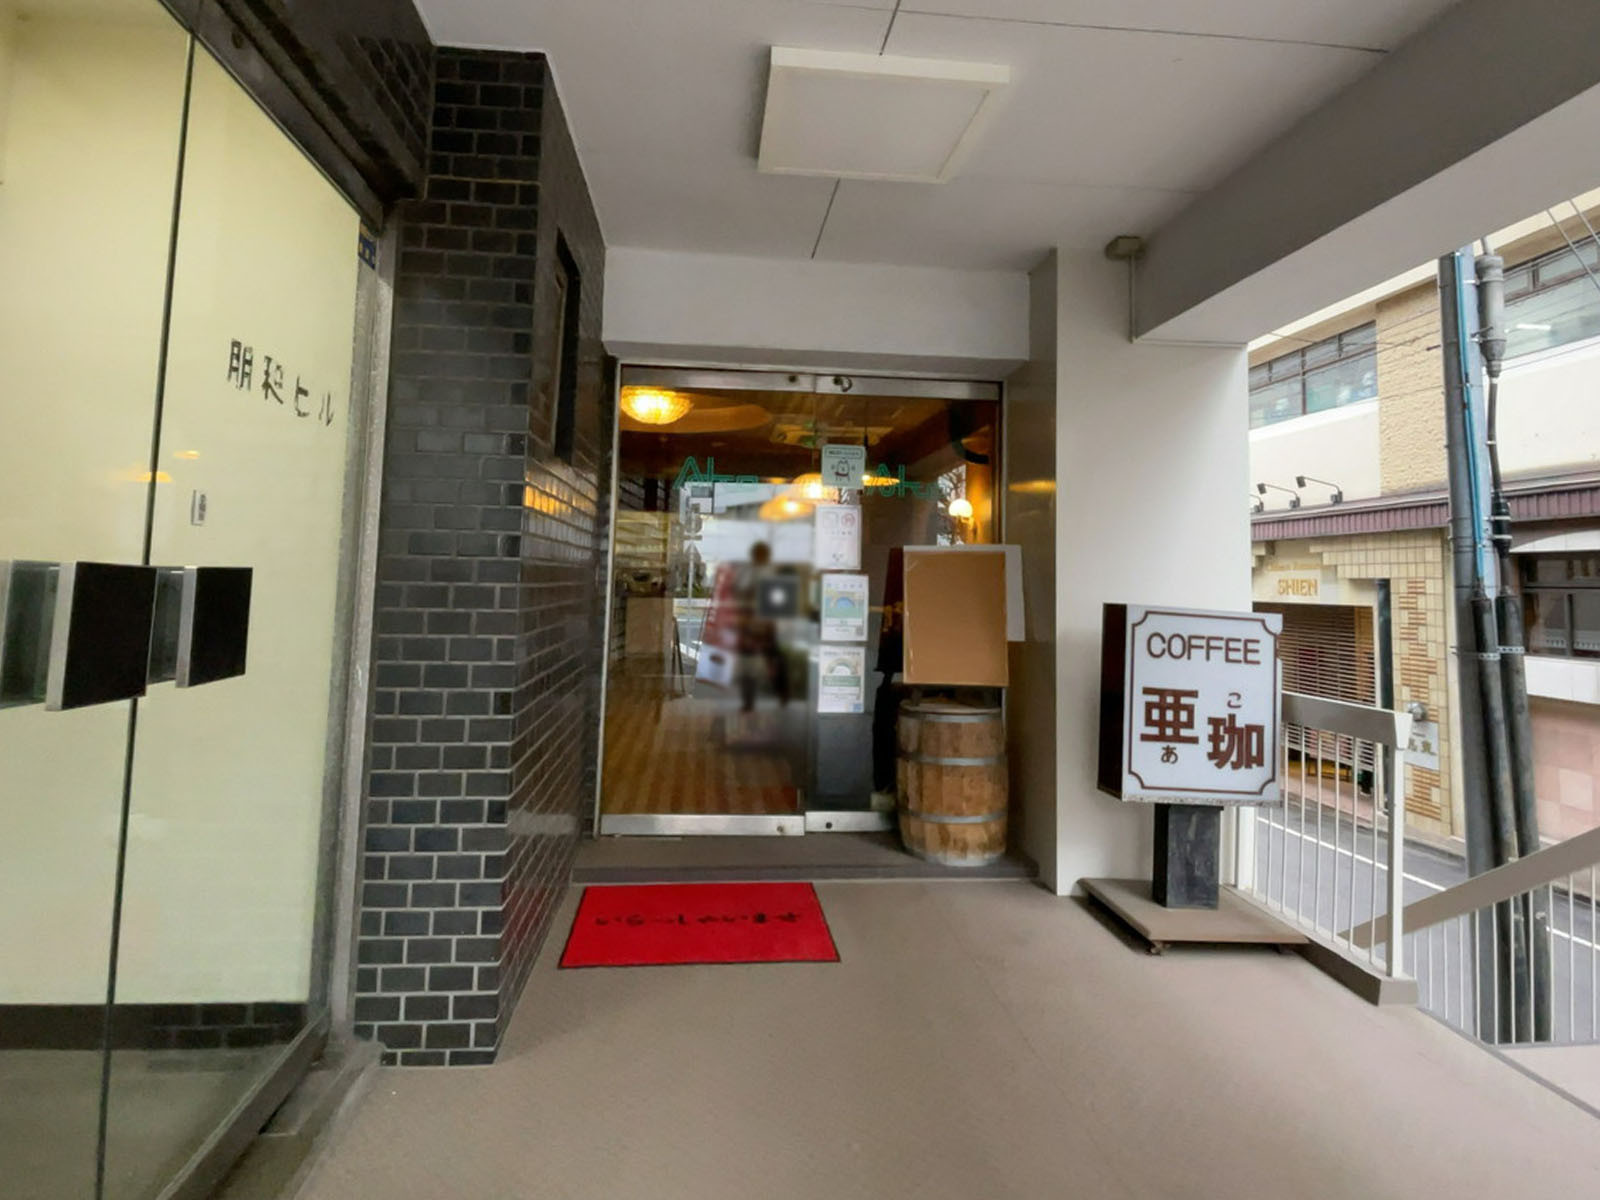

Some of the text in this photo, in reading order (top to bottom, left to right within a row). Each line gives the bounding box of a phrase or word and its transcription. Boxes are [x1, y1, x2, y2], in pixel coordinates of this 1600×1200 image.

[1146, 631, 1261, 666] COFFEE
[1226, 691, 1243, 710] こ
[1160, 744, 1179, 765] あ
